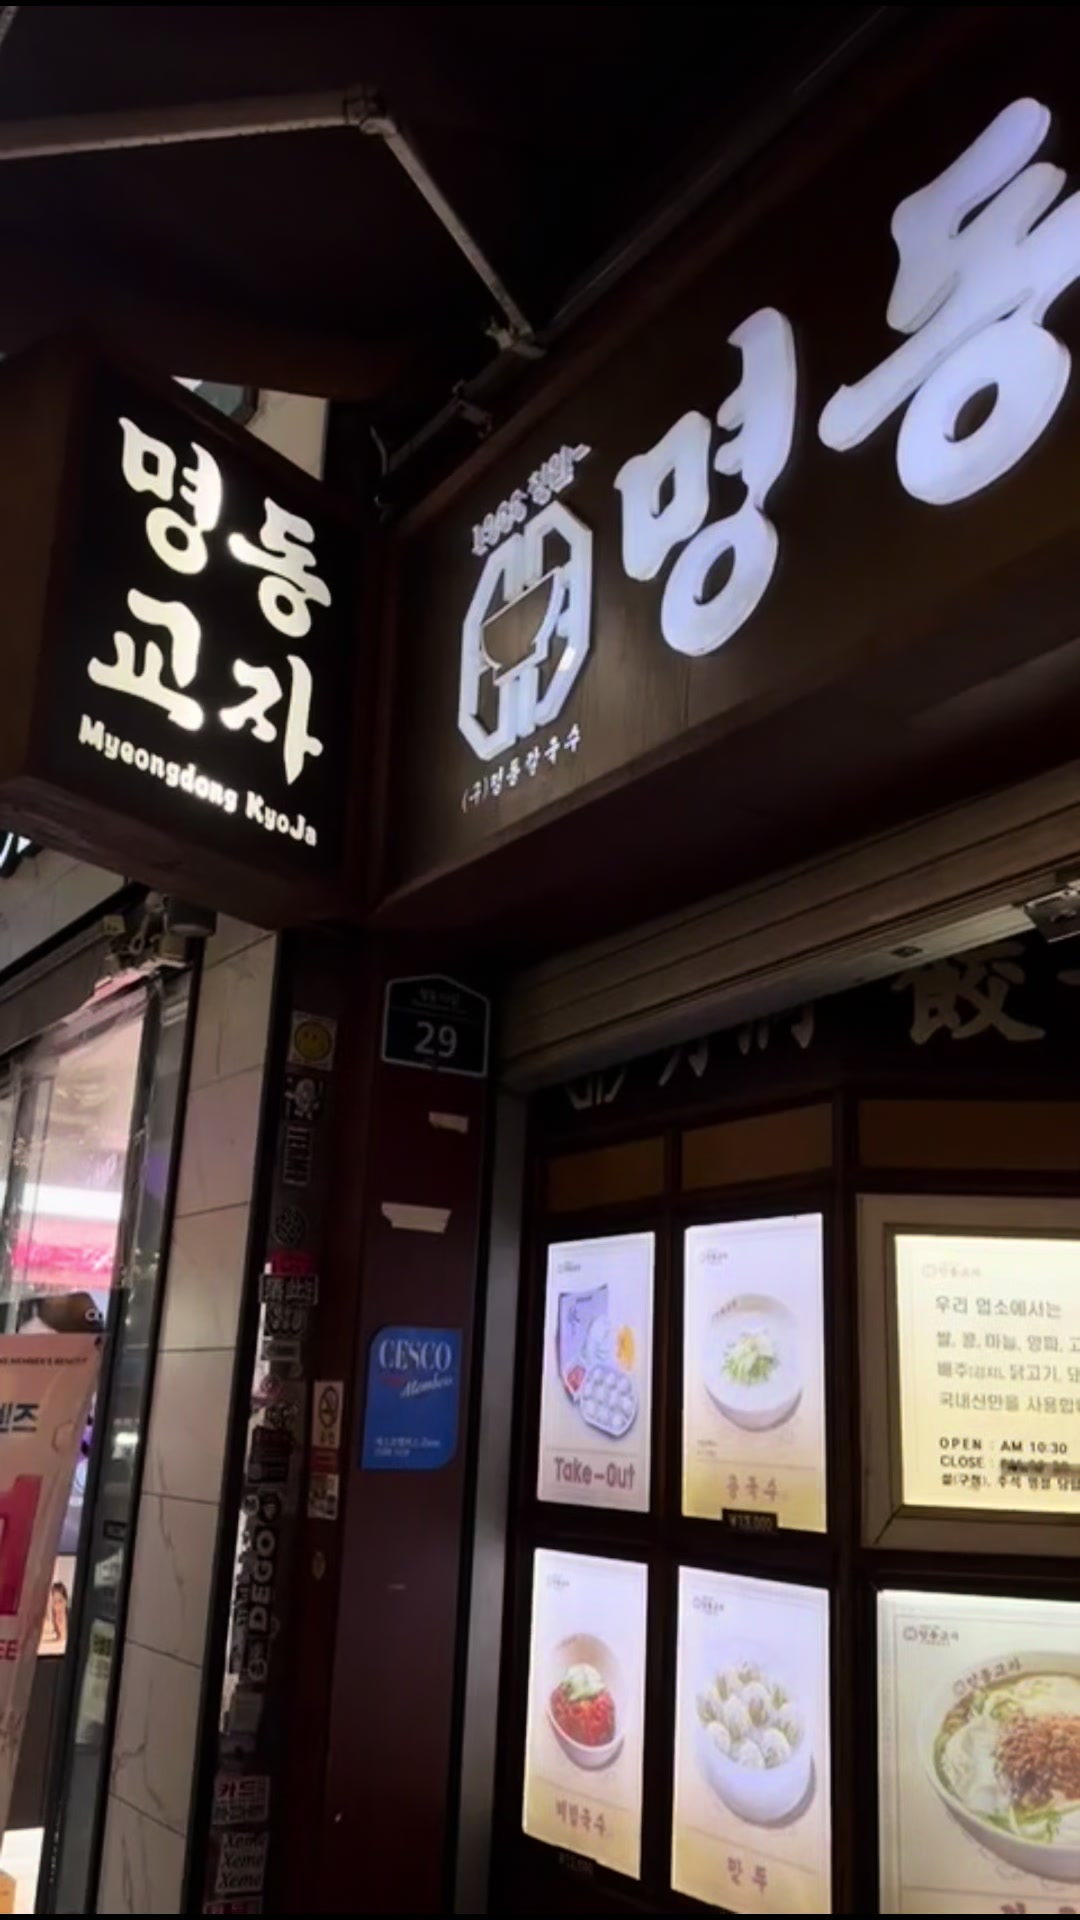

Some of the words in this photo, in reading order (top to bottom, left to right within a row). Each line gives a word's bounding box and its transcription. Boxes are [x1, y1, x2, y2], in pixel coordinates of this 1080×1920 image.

[614, 97, 1080, 657] 명동
[118, 417, 331, 637] 명동
[88, 589, 323, 785] 교자
[79, 715, 238, 813] Myeongdong
[245, 791, 317, 847] KyoJa
[415, 1021, 457, 1058] 29
[935, 1295, 968, 1314] 우리
[975, 1298, 1062, 1319] 업소에서는
[380, 1339, 452, 1371] CESCO
[939, 1437, 982, 1450] OPEN
[1001, 1440, 1023, 1452] AM
[1029, 1441, 1067, 1454] 10:30
[940, 1455, 984, 1468] CLOSE
[554, 1457, 635, 1490] Take-Out
